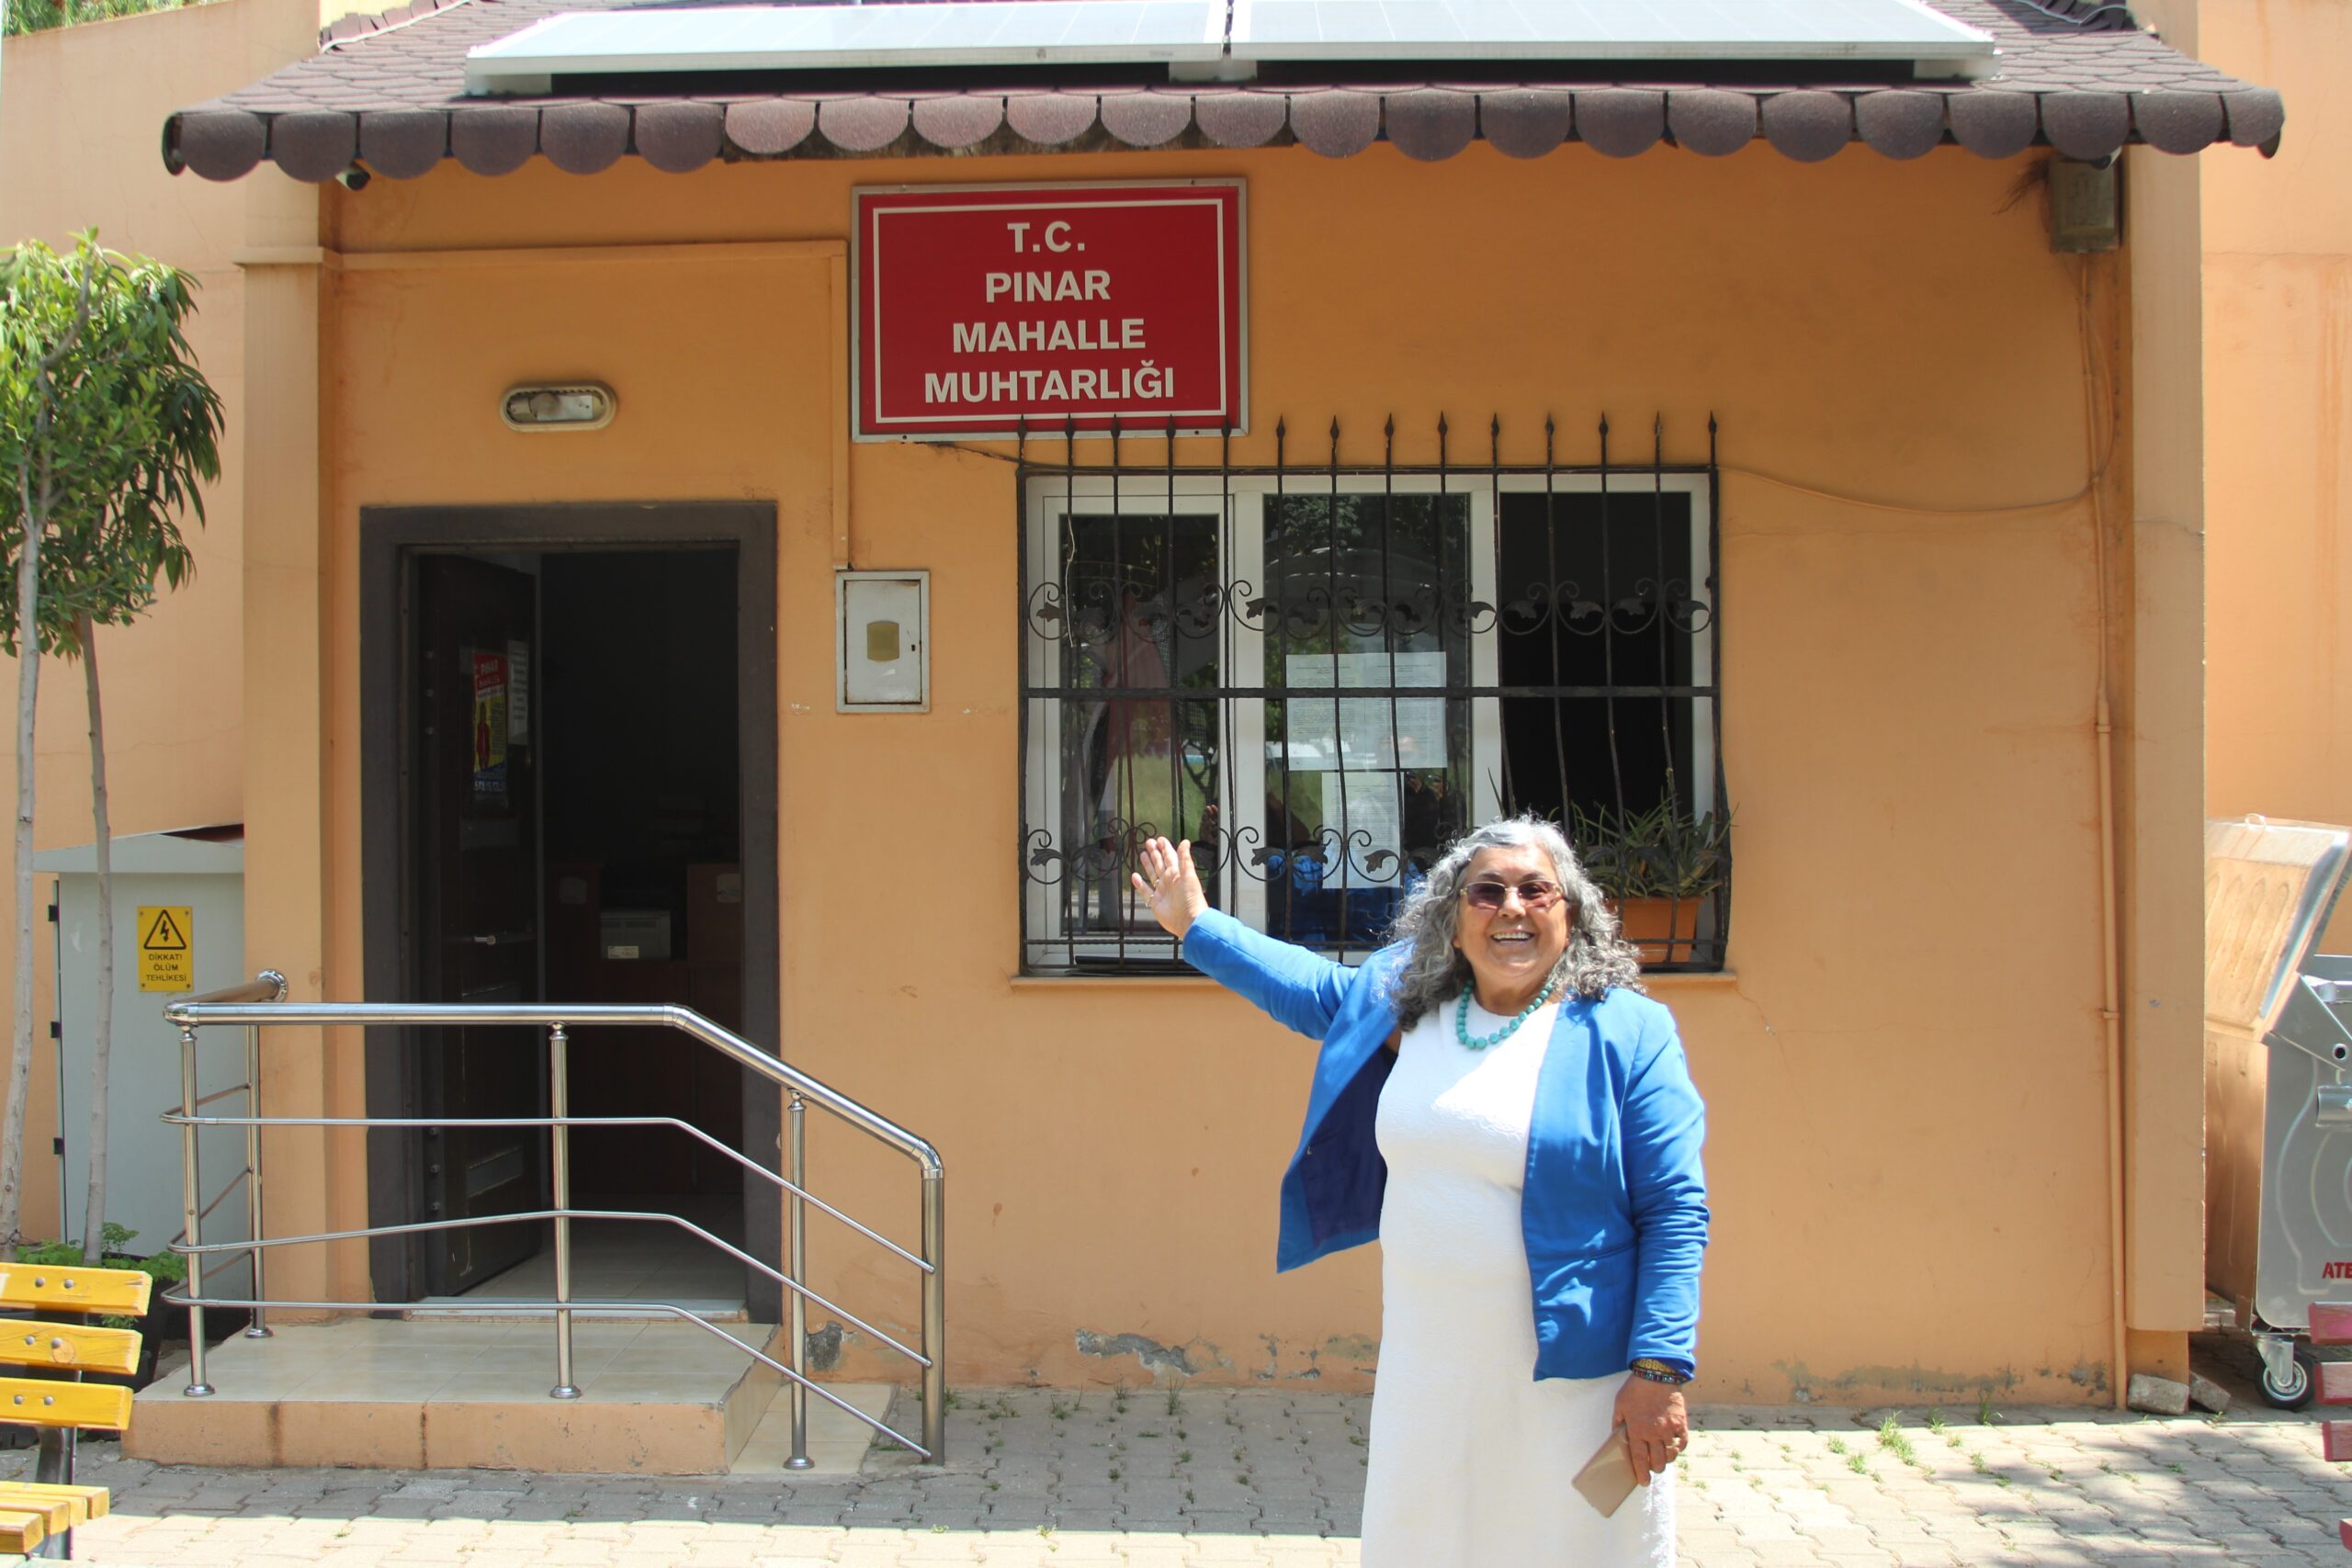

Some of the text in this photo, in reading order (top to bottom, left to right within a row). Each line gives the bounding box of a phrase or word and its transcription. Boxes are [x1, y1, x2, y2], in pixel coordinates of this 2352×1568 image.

[1007, 220, 1085, 254] T.C.
[986, 270, 1111, 303] PINAR
[953, 318, 1146, 353] MAHALLE
[924, 359, 1174, 403] MUHTARLIĞI
[148, 953, 183, 961] DİKKAT!
[153, 963, 178, 971] ÖLÜM
[146, 973, 187, 982] TEHLİKESİ
